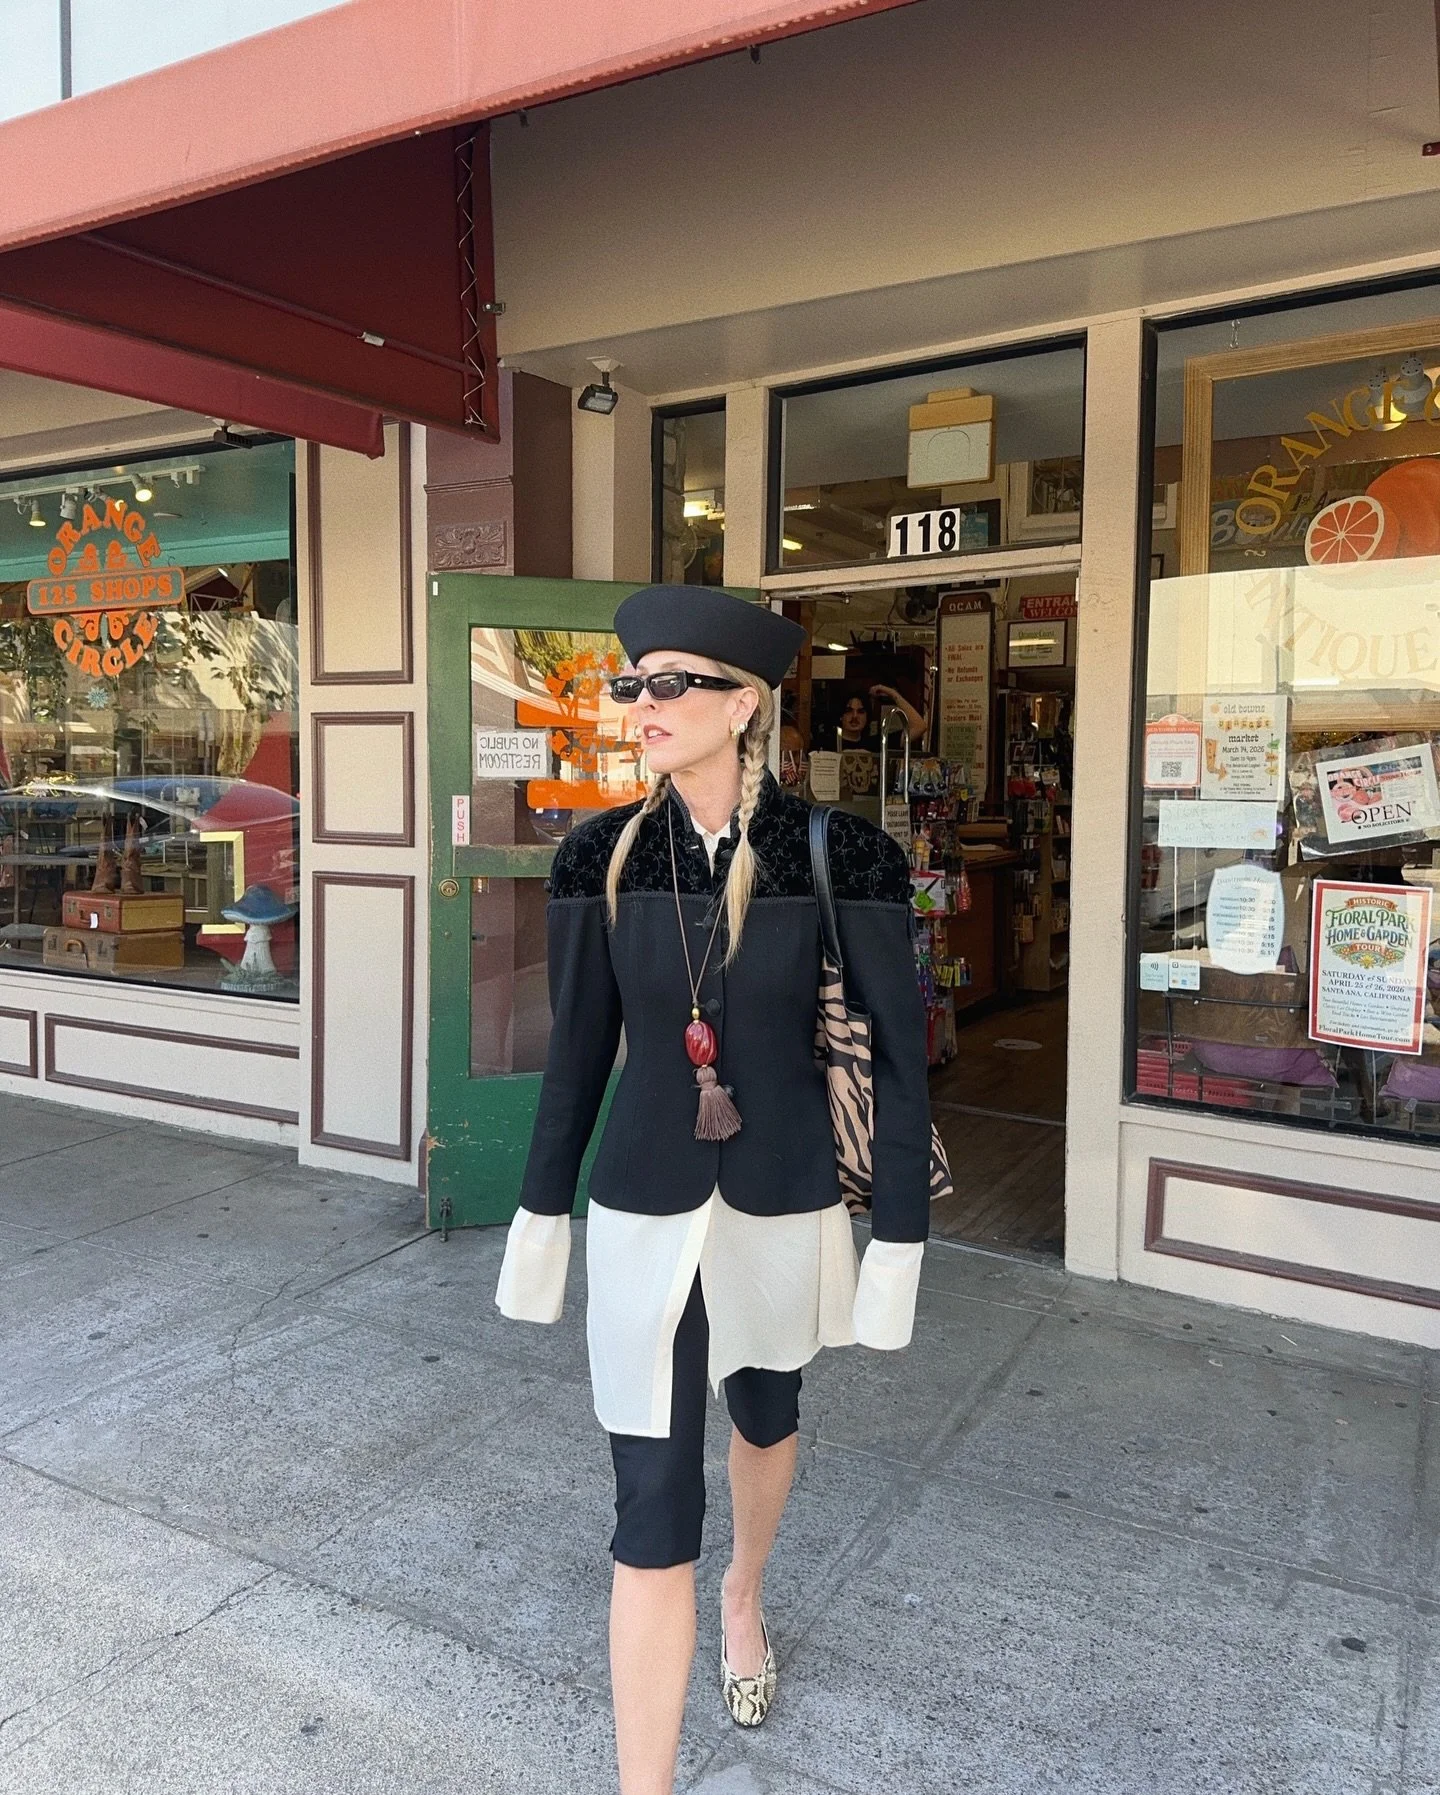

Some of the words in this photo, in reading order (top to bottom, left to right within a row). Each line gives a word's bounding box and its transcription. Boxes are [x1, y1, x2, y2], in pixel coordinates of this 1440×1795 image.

[1235, 380, 1408, 536] ORANGE
[47, 497, 161, 576] ORANGE
[895, 511, 956, 555] 118
[38, 585, 77, 606] 125
[89, 574, 173, 603] SHOPS
[1029, 606, 1076, 618] WELCO
[53, 612, 158, 678] CIRCLE
[1228, 734, 1260, 743] market
[457, 798, 465, 843] PUSH
[1351, 801, 1413, 825] OPEN
[1372, 819, 1405, 828] SOLICITORS
[1353, 897, 1391, 908] HISTORIC
[1325, 908, 1376, 928] FLORAL
[1376, 909, 1416, 933] PARK
[1325, 928, 1360, 946] HOME
[1360, 929, 1366, 938] &
[1366, 926, 1413, 949] GARDEN
[1355, 943, 1381, 953] TOUR
[1321, 969, 1366, 982] SATURDAY
[1376, 975, 1413, 986] SUNDAY
[1328, 979, 1354, 988] APRIL
[1374, 983, 1385, 992] 26,
[1386, 985, 1405, 993] 2026
[1321, 986, 1345, 995] SANTA
[1345, 989, 1362, 998] ANA,
[1363, 990, 1411, 1002] CALIFORNIA
[1319, 1025, 1411, 1043] FloralParkHomeTour.com
